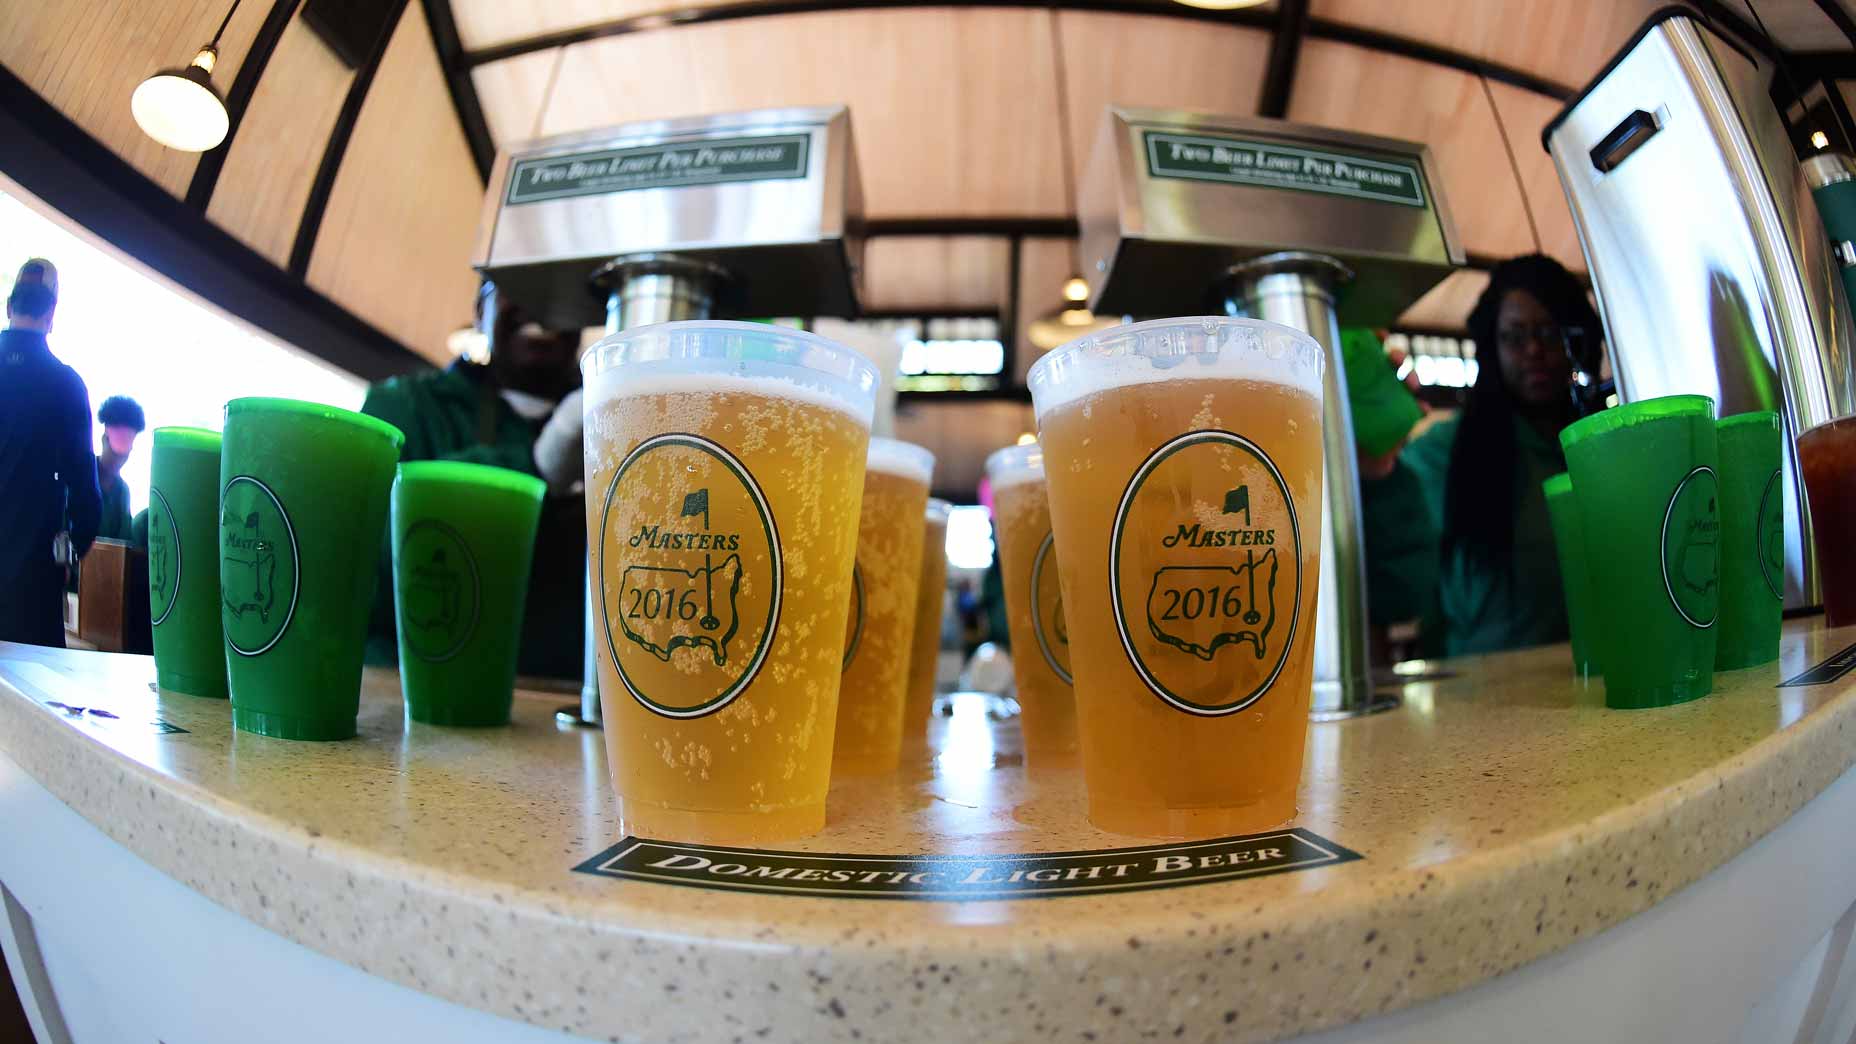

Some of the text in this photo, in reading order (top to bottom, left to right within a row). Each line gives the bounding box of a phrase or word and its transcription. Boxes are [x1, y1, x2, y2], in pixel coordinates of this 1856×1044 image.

[629, 525, 740, 550] MASTERS
[1163, 524, 1275, 548] MASTERS
[628, 588, 698, 621] 2016
[1161, 586, 1241, 621] 2016
[644, 847, 1287, 885] DOMESTIC LIGHT BEER
